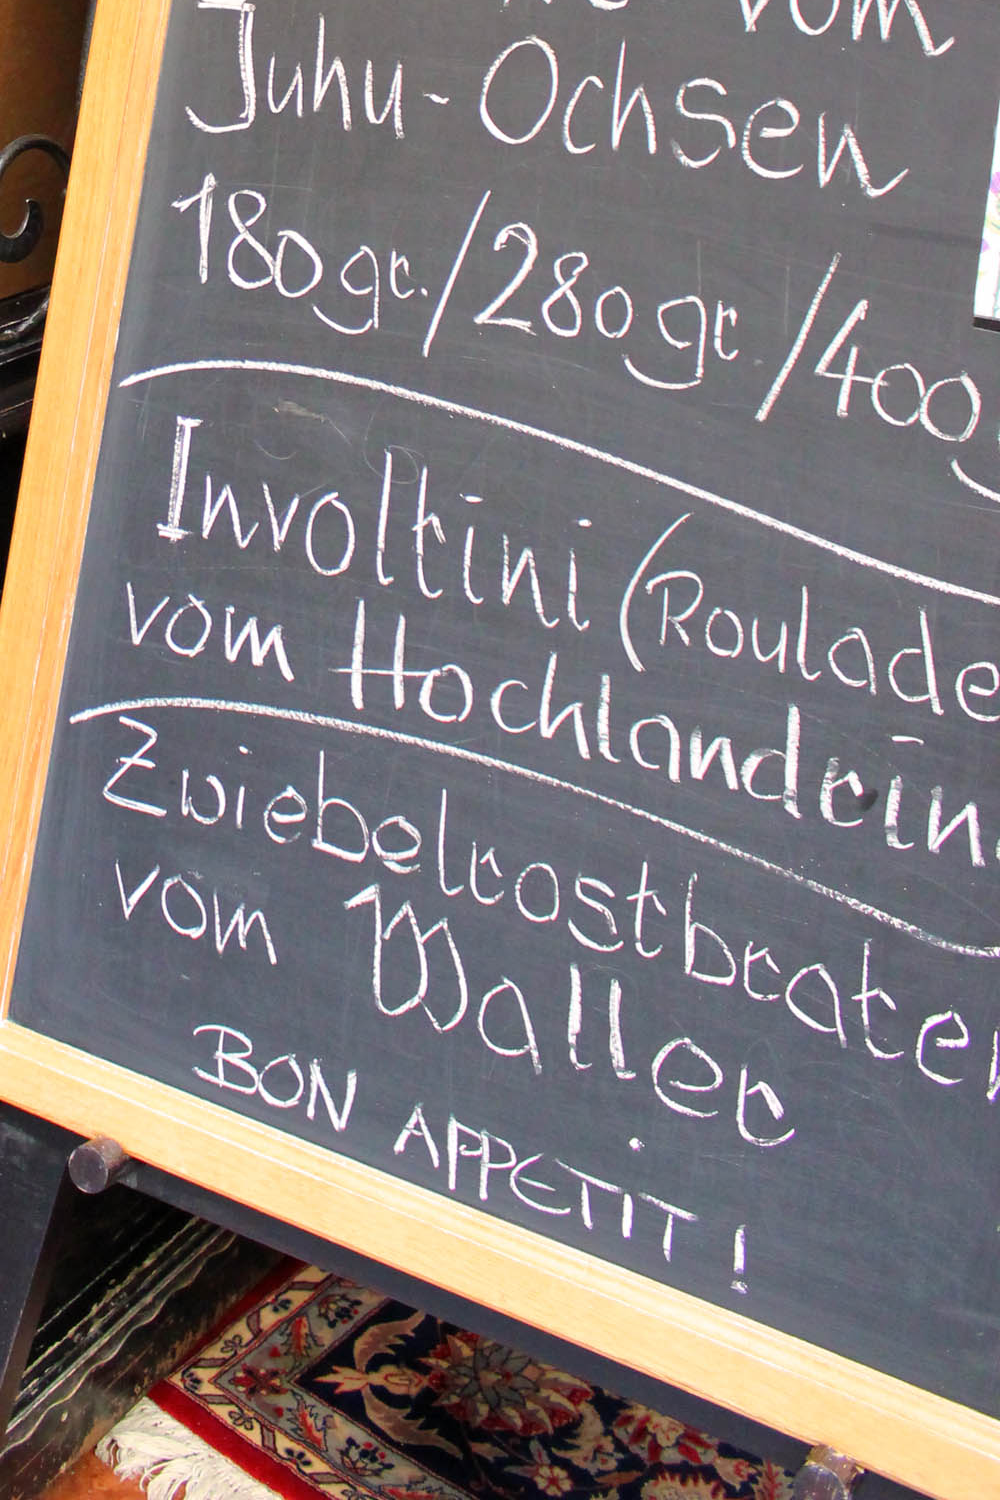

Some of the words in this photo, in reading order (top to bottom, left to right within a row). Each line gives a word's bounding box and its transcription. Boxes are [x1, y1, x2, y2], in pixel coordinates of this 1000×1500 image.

[157, 416, 589, 631] Involtini
[328, 599, 1000, 868] Hochlandrin
[193, 1025, 356, 1131] BON
